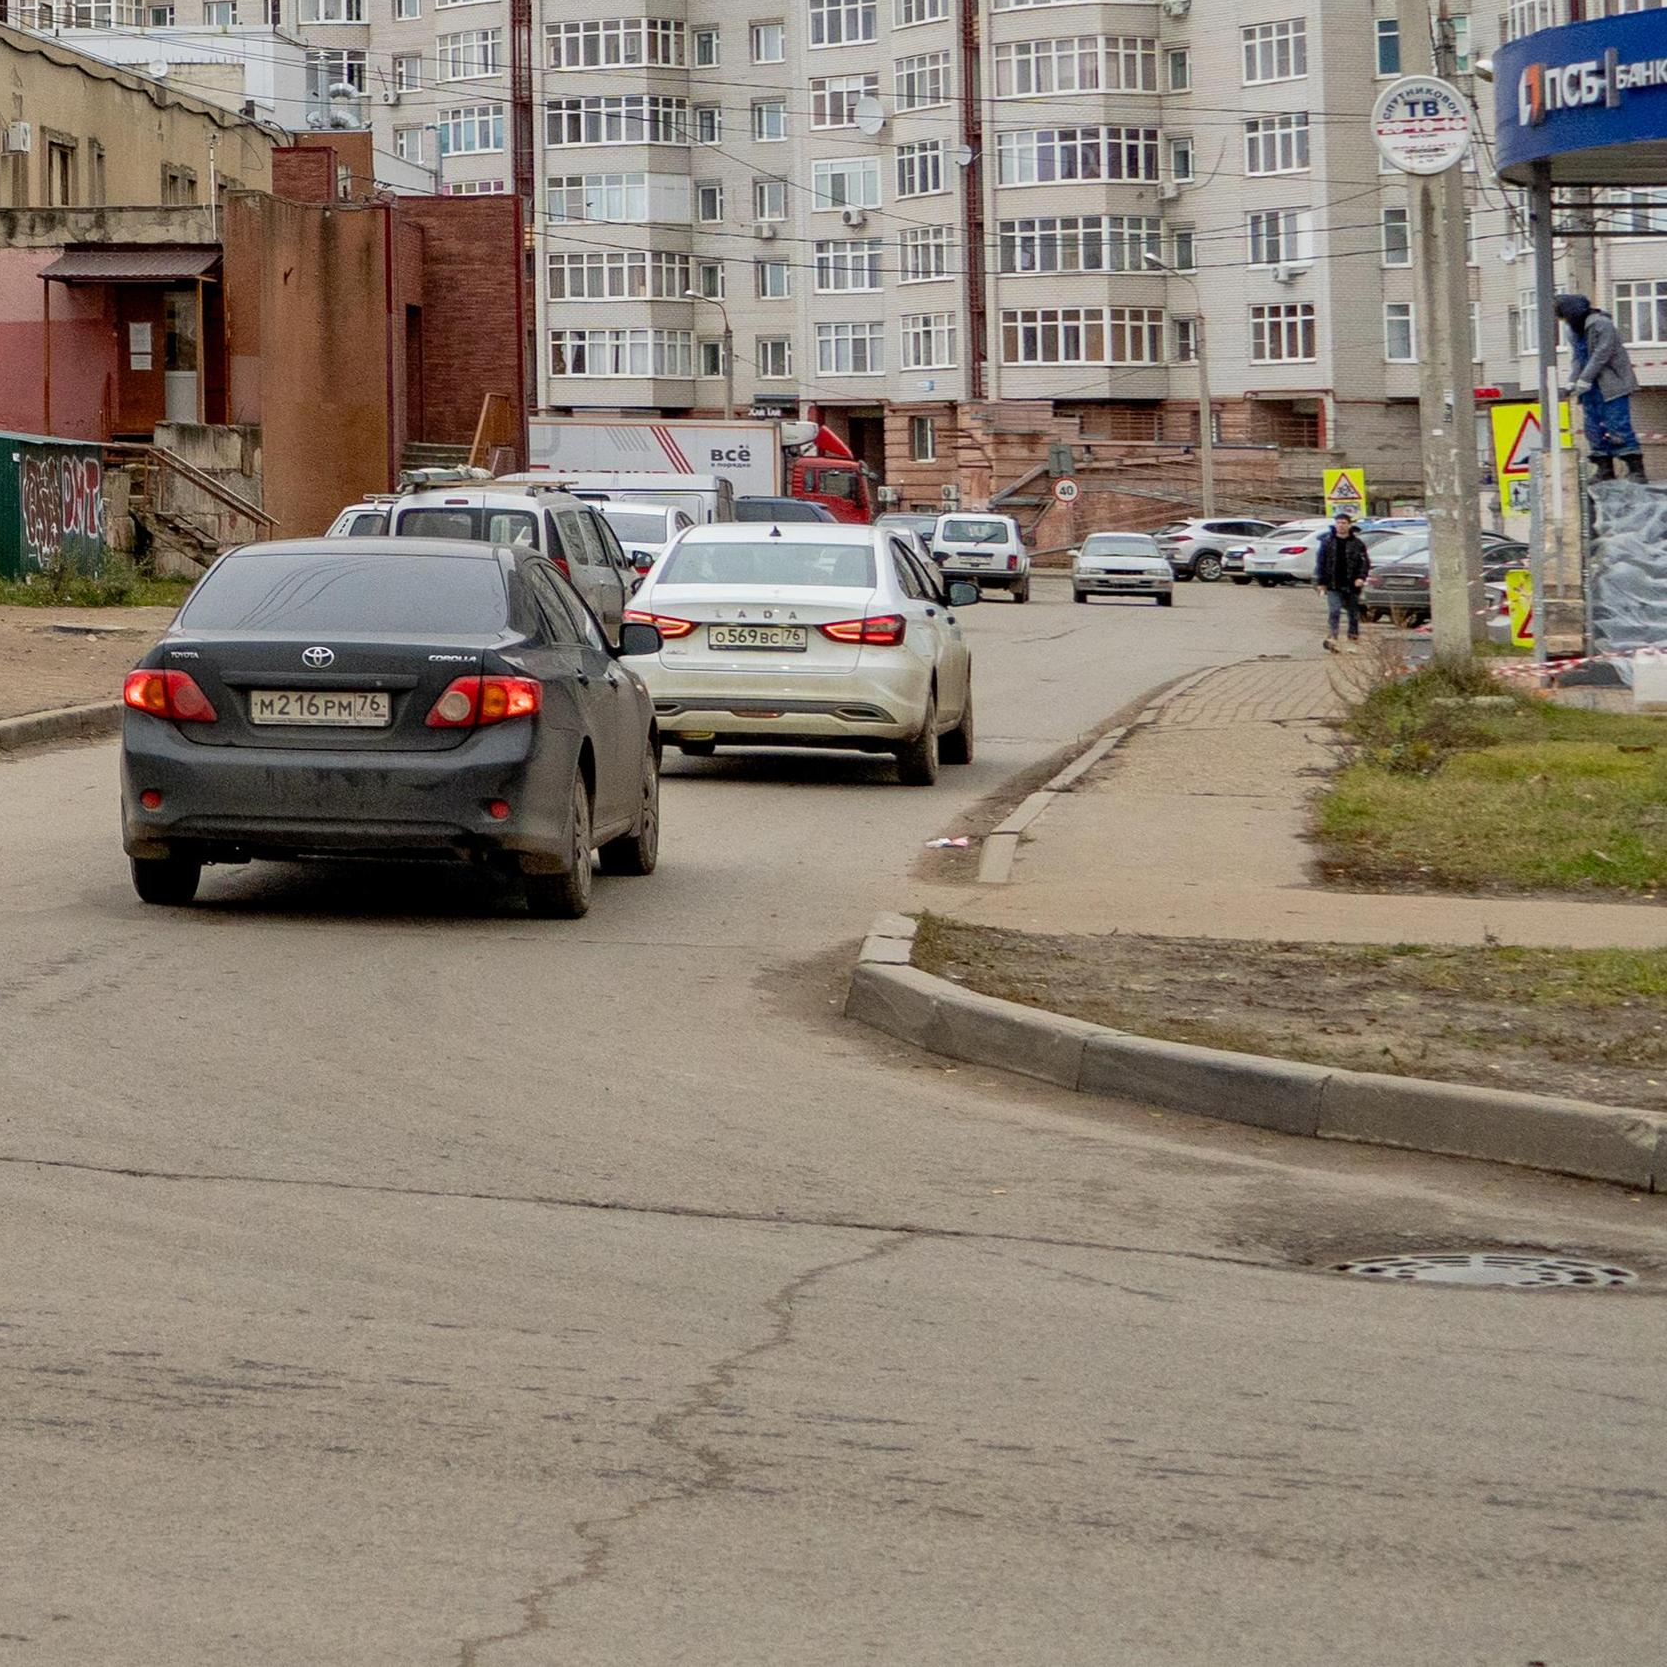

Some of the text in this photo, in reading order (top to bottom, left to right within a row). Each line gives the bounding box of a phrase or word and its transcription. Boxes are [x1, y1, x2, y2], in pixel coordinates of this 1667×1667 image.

[1544, 60, 1599, 107] ПСБ
[1616, 59, 1667, 90] БАНК
[1383, 87, 1461, 120] СПУТНИКОВОЕ
[1403, 99, 1440, 118] ТВ
[710, 444, 751, 462] всё
[1059, 485, 1074, 496] 40
[715, 609, 797, 620] LADA
[785, 629, 801, 641] 76
[170, 651, 200, 659] TOYOTA
[260, 694, 381, 717] М216РМ 76
